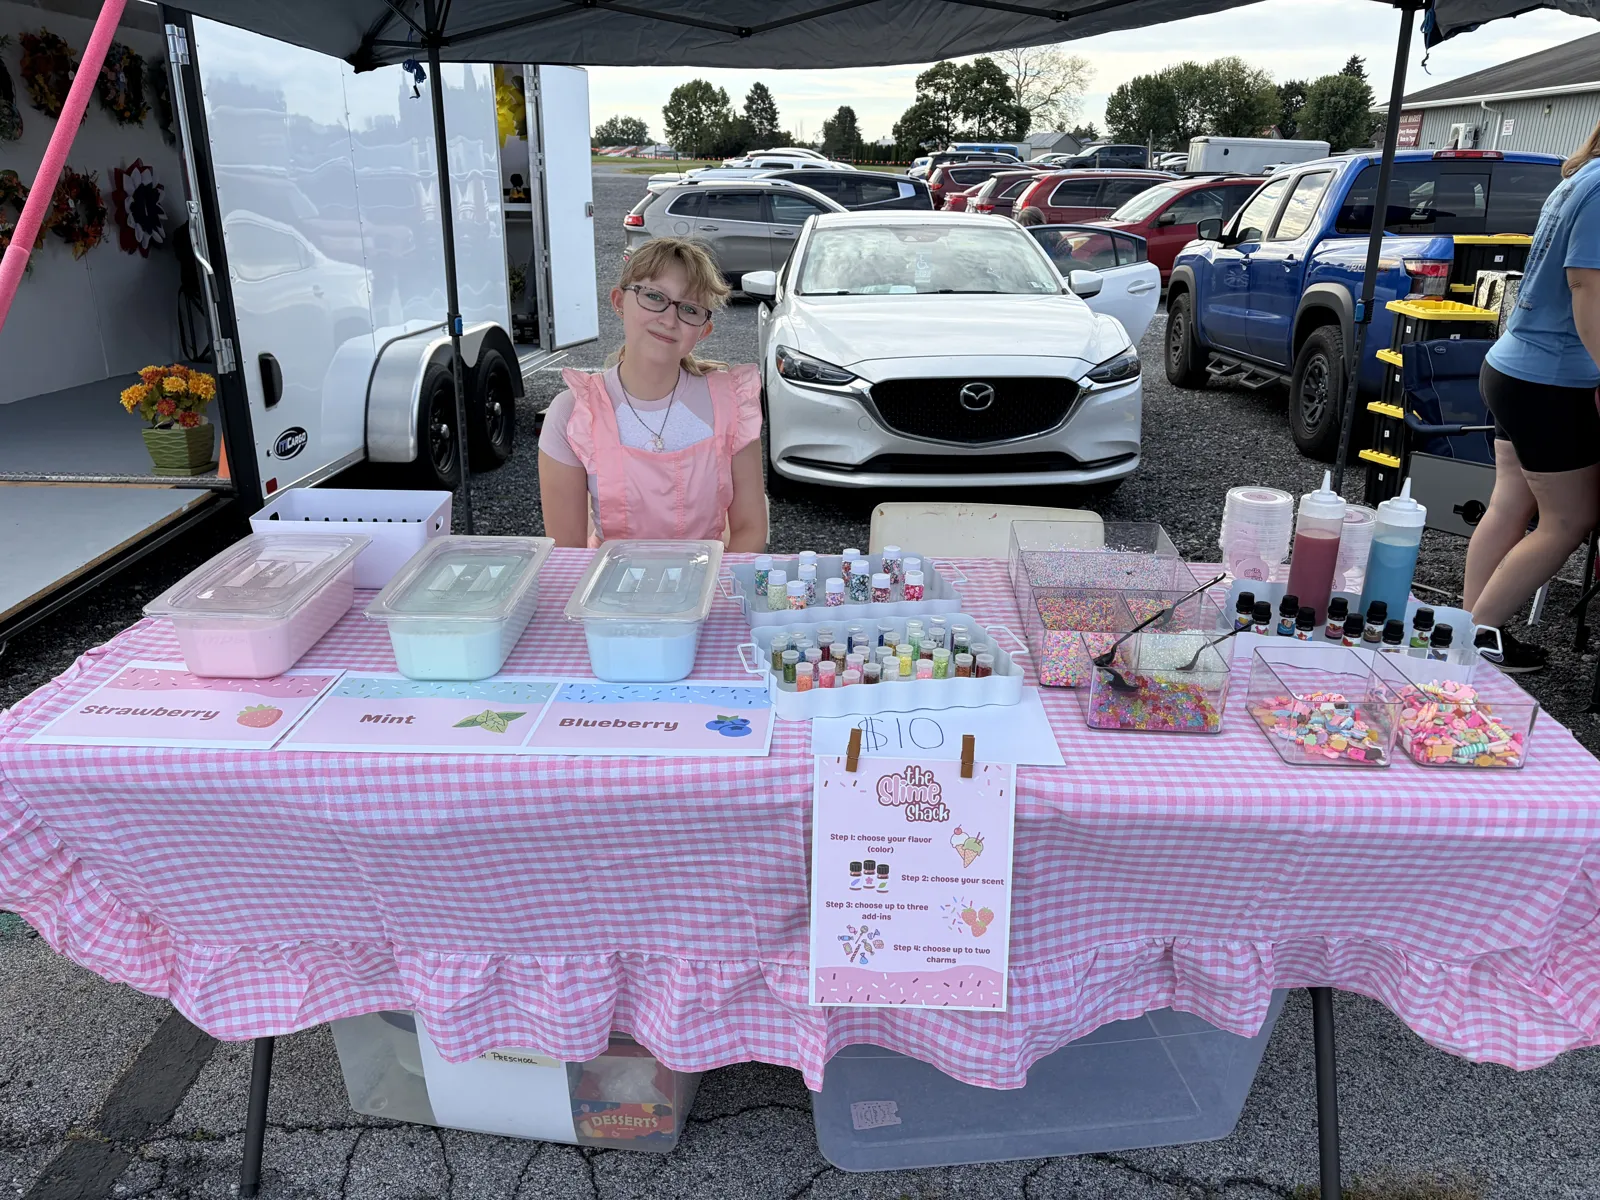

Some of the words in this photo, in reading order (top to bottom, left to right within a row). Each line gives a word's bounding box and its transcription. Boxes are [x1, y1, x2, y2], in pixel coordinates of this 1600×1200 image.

[79, 704, 220, 721] Strawberry
[359, 713, 417, 725] Mint
[558, 718, 679, 732] Blueberry
[857, 716, 944, 753] $10
[904, 765, 934, 786] the
[876, 773, 942, 807] Slime
[830, 833, 849, 843] Step
[856, 834, 886, 842] choose
[887, 836, 907, 844] your
[908, 835, 932, 844] flavor
[867, 845, 894, 854] (color)
[901, 874, 920, 883] Step
[930, 876, 960, 884] choose
[960, 877, 980, 886] your
[981, 877, 1005, 886] scent
[825, 901, 844, 910] Step
[845, 901, 853, 909] 3:
[854, 901, 884, 910] choose
[884, 903, 895, 911] up
[896, 902, 905, 910] to
[906, 903, 929, 911] three
[861, 912, 892, 921] add-ins
[893, 944, 912, 953] Step
[922, 945, 951, 953] choose
[952, 947, 963, 955] up
[964, 946, 973, 954] to
[974, 947, 991, 955] two
[926, 956, 957, 964] charms
[590, 1114, 658, 1128] DESSERTS
